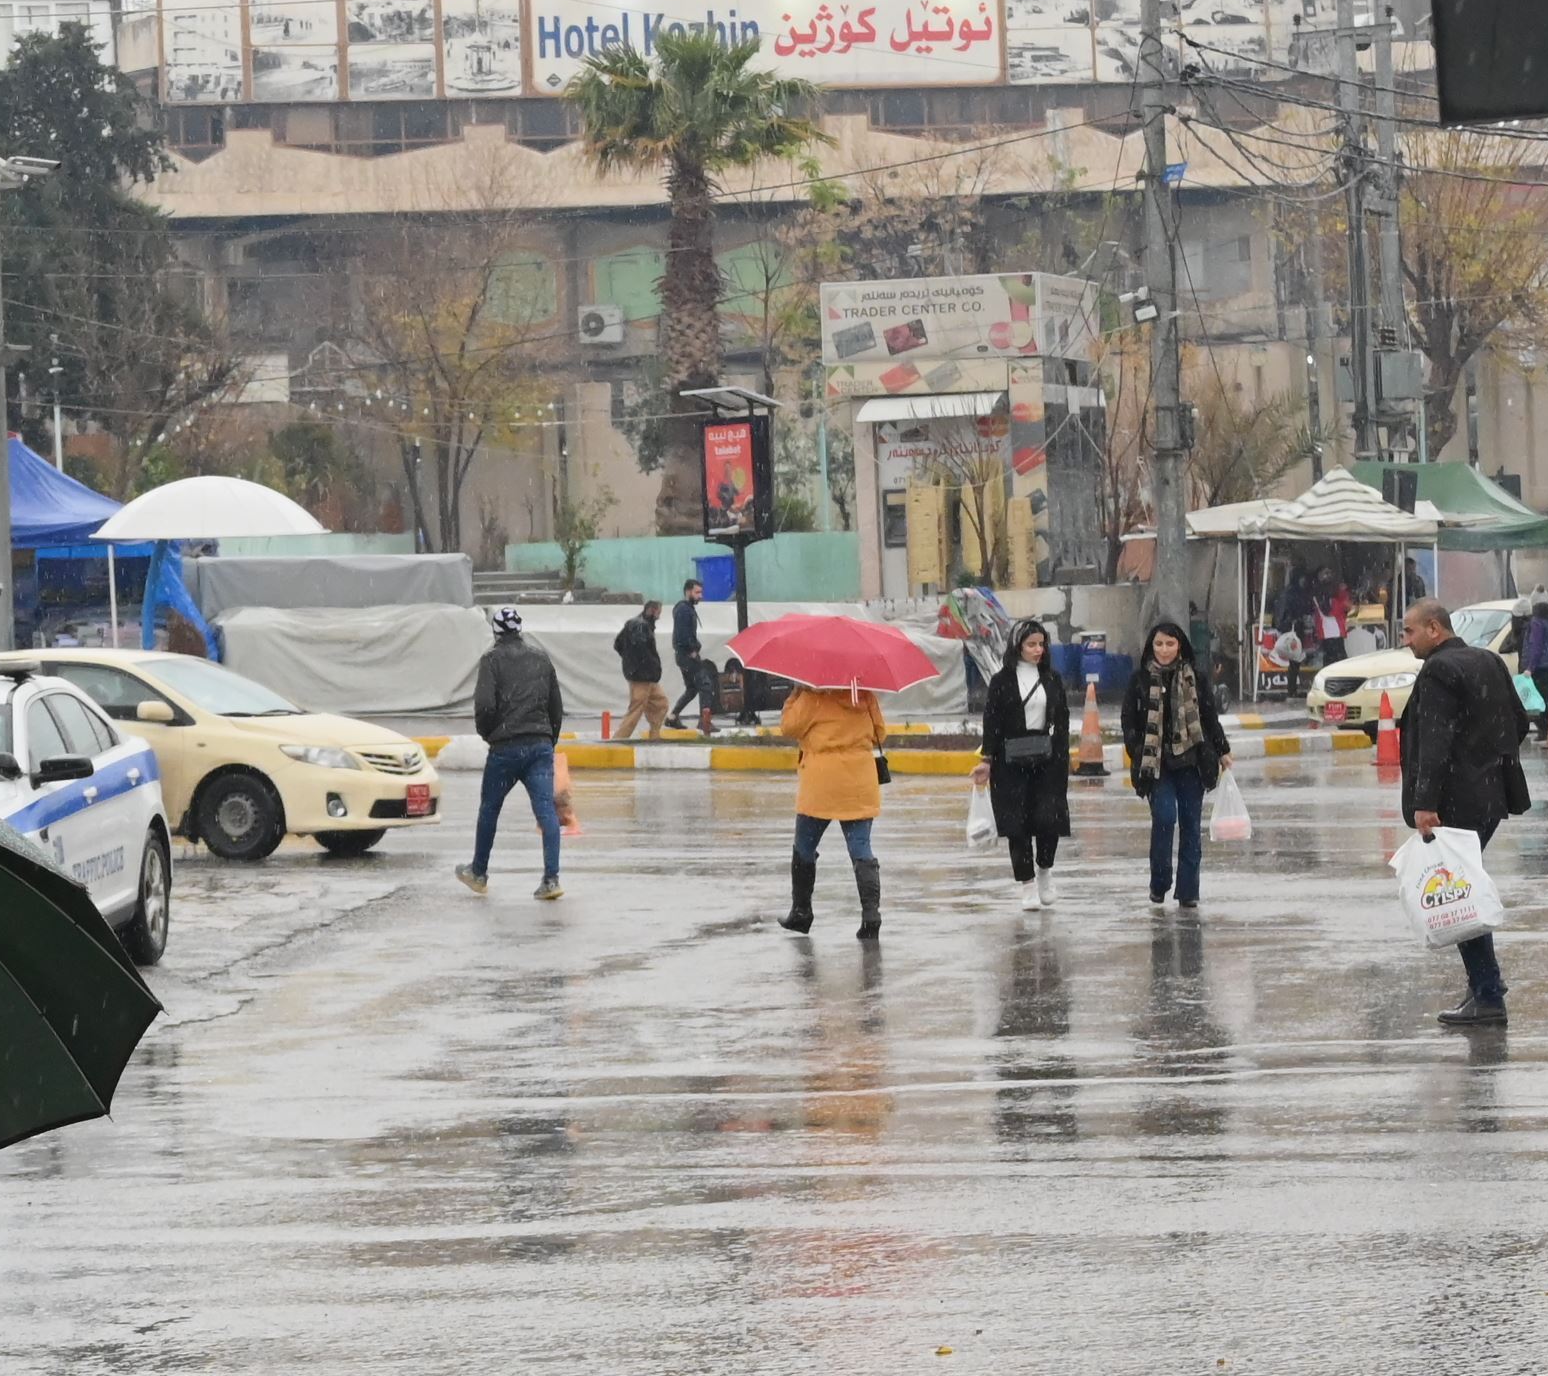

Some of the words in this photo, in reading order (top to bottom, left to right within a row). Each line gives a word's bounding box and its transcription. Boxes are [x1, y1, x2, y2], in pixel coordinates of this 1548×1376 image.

[538, 12, 628, 58] Hotel
[843, 306, 897, 319] TRADER
[901, 302, 957, 315] CENTER
[961, 300, 985, 313] CO.
